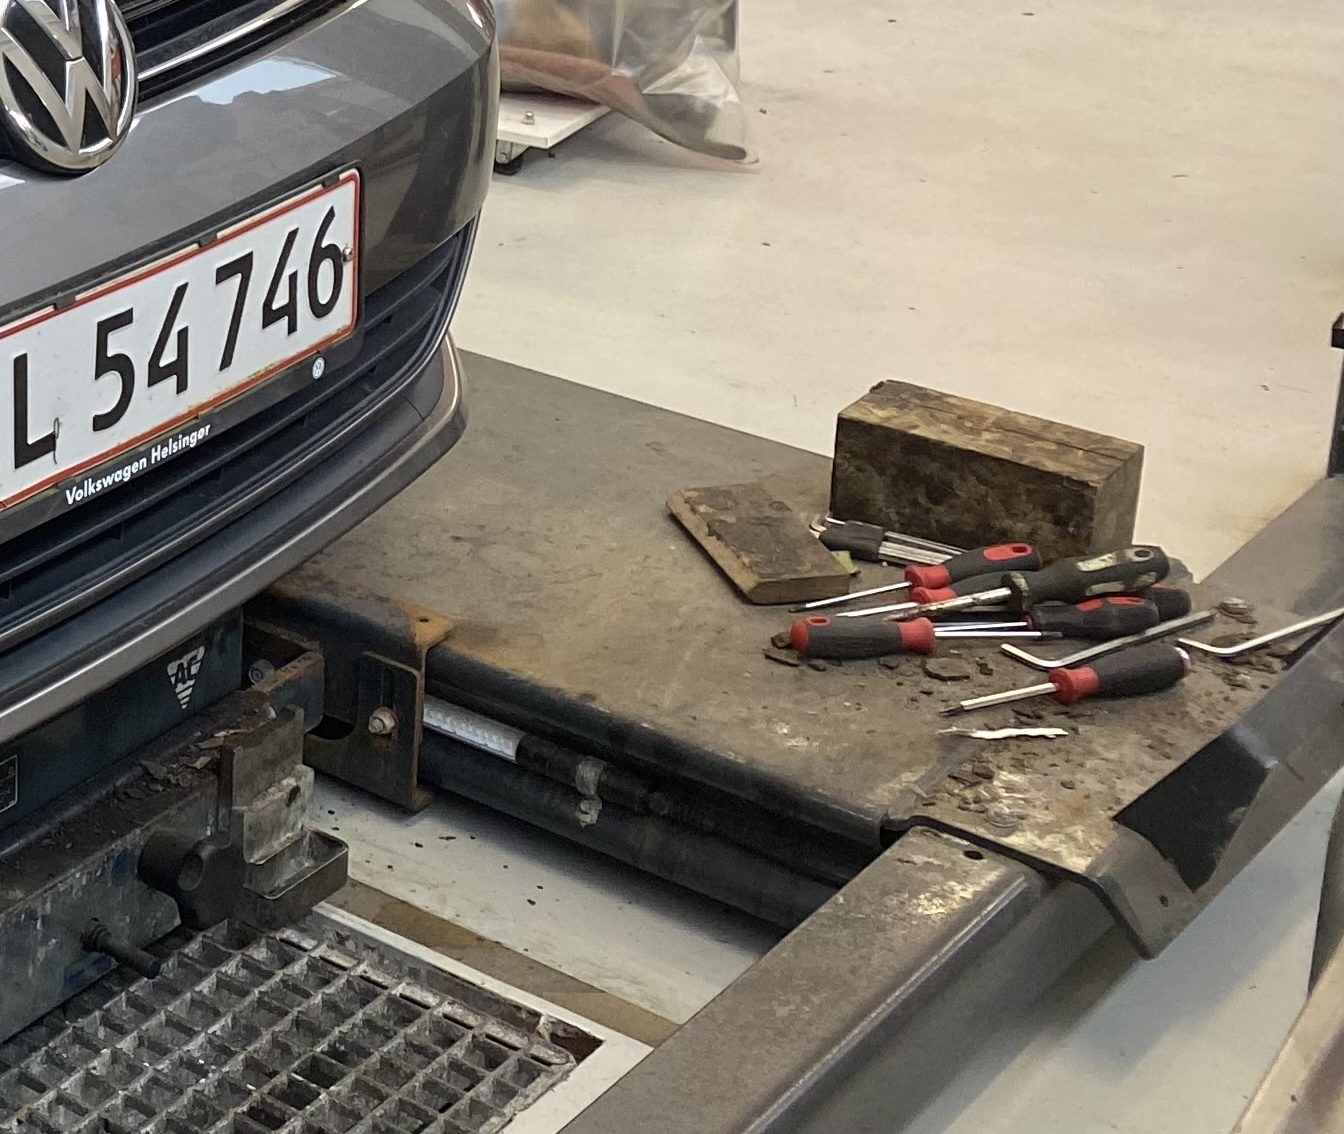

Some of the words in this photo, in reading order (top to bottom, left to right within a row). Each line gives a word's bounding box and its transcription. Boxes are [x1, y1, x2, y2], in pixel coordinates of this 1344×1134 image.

[93, 282, 190, 432] 54
[215, 205, 343, 372] 746
[65, 457, 147, 505] Volkswagen
[151, 424, 211, 464] Helsingør
